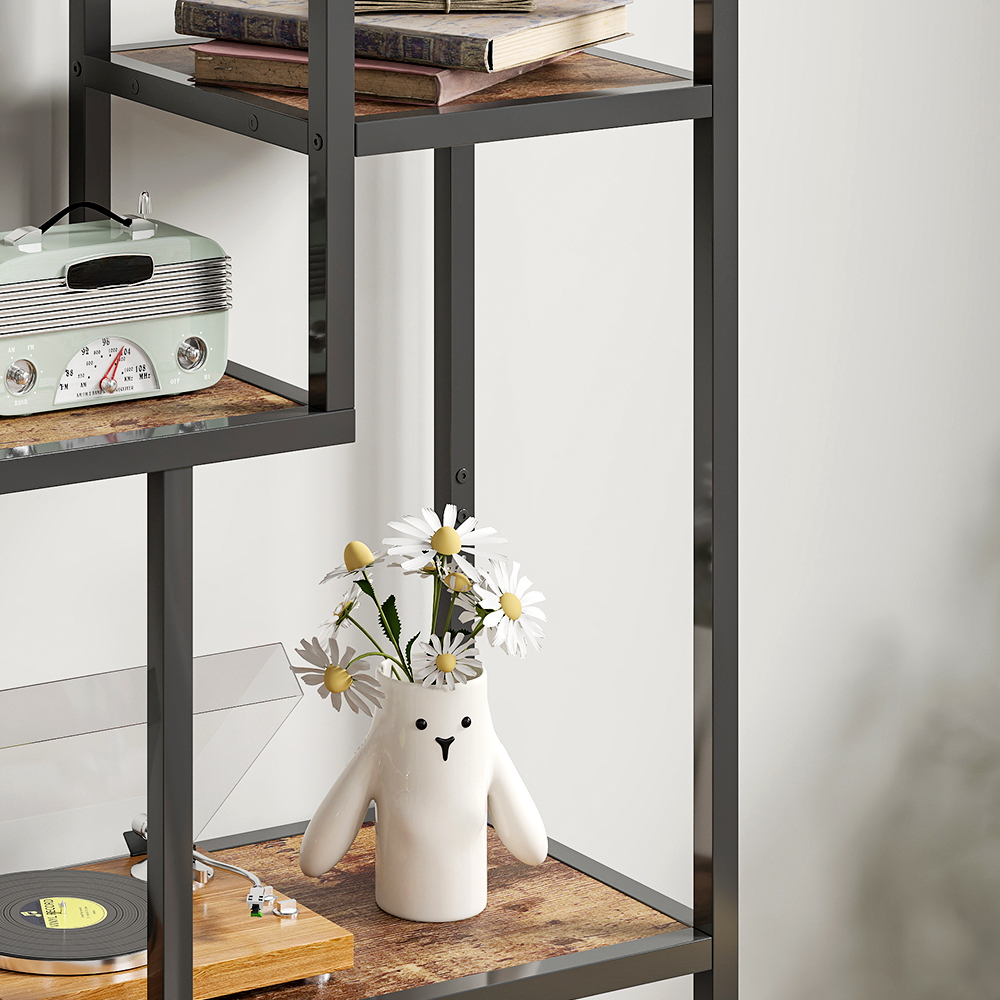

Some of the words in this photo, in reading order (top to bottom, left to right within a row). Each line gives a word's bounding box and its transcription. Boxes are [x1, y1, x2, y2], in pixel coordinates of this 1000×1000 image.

[101, 337, 111, 347] 96
[80, 346, 90, 356] 92
[65, 369, 74, 377] 88
[135, 364, 147, 373] 108
[138, 372, 151, 380] MHz
[59, 383, 69, 391] FM
[43, 898, 56, 916] RECORD
